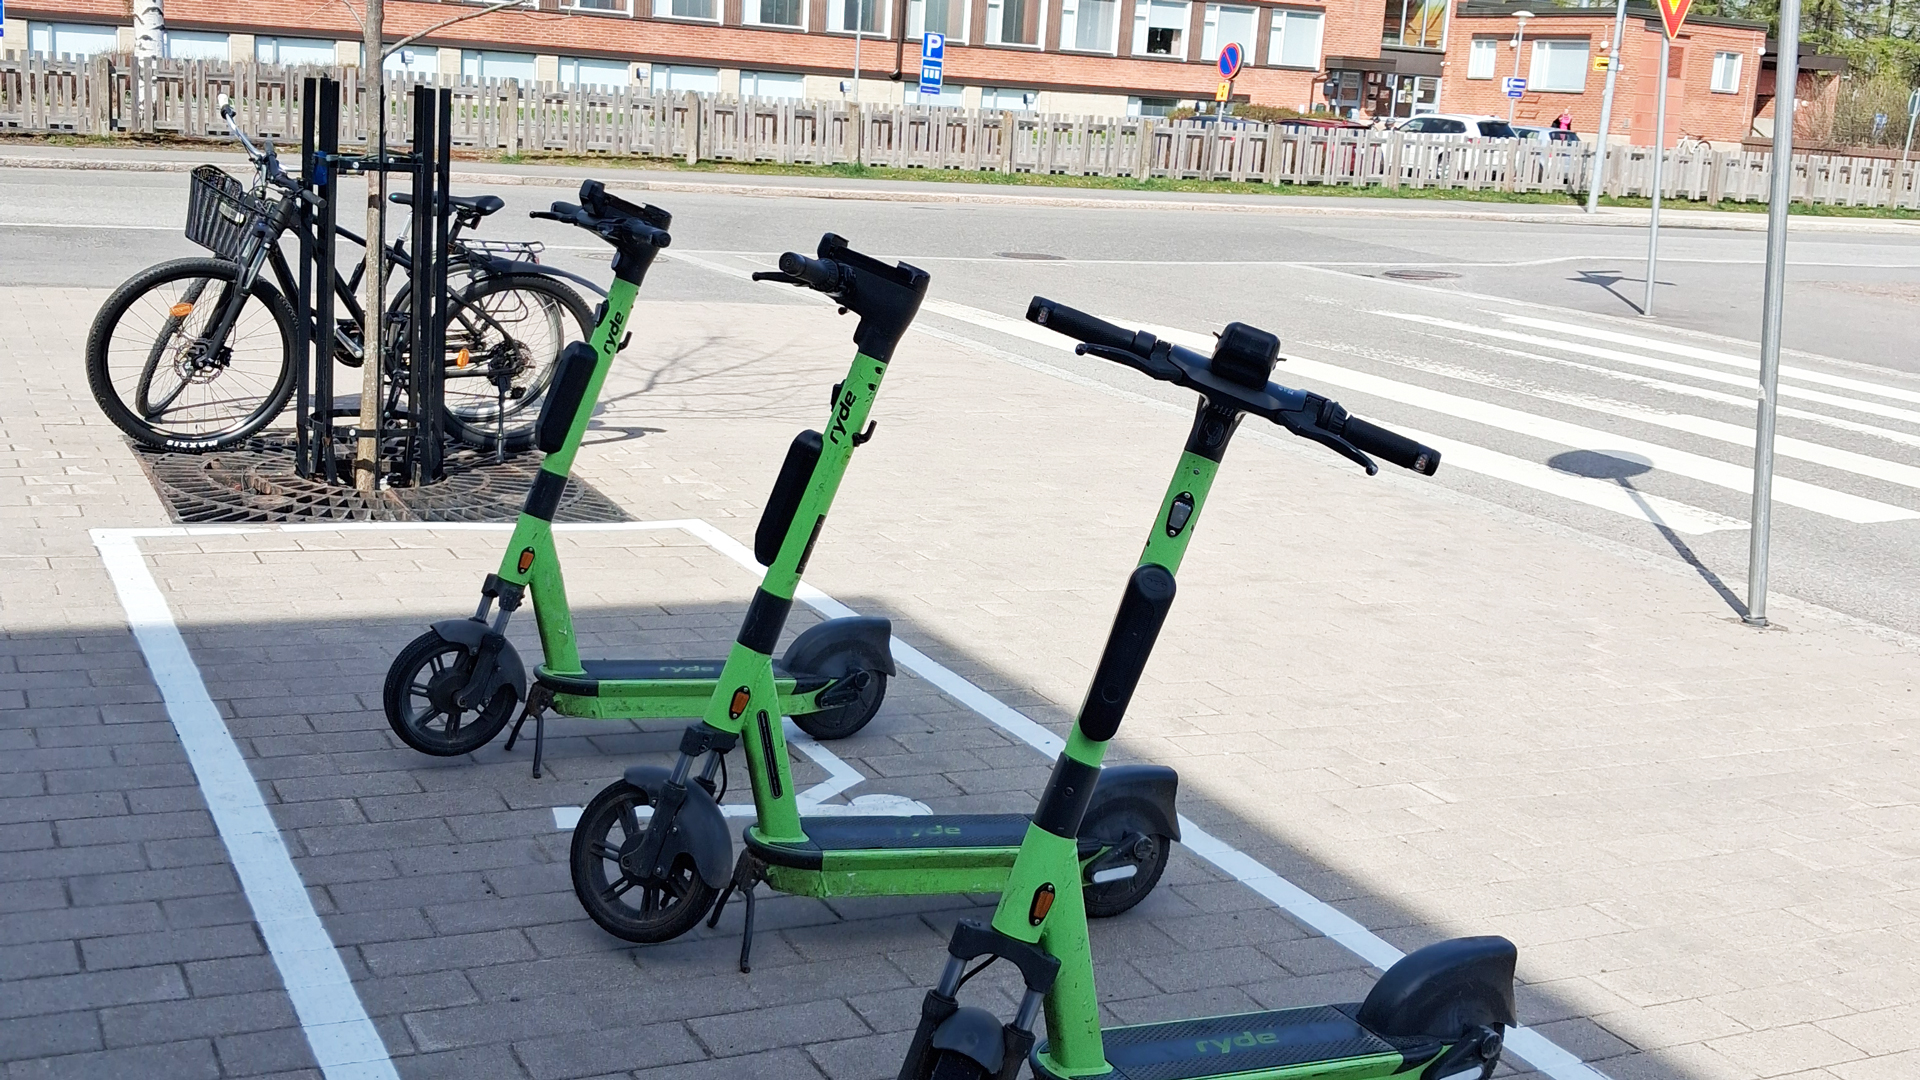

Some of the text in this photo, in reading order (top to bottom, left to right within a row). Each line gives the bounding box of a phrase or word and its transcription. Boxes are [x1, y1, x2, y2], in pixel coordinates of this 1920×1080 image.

[926, 34, 942, 57] P
[603, 311, 625, 355] ryde
[829, 390, 857, 445] ryde
[166, 439, 218, 448] MAXXIS
[659, 665, 715, 673] ryde
[1195, 1030, 1280, 1054] ryde
